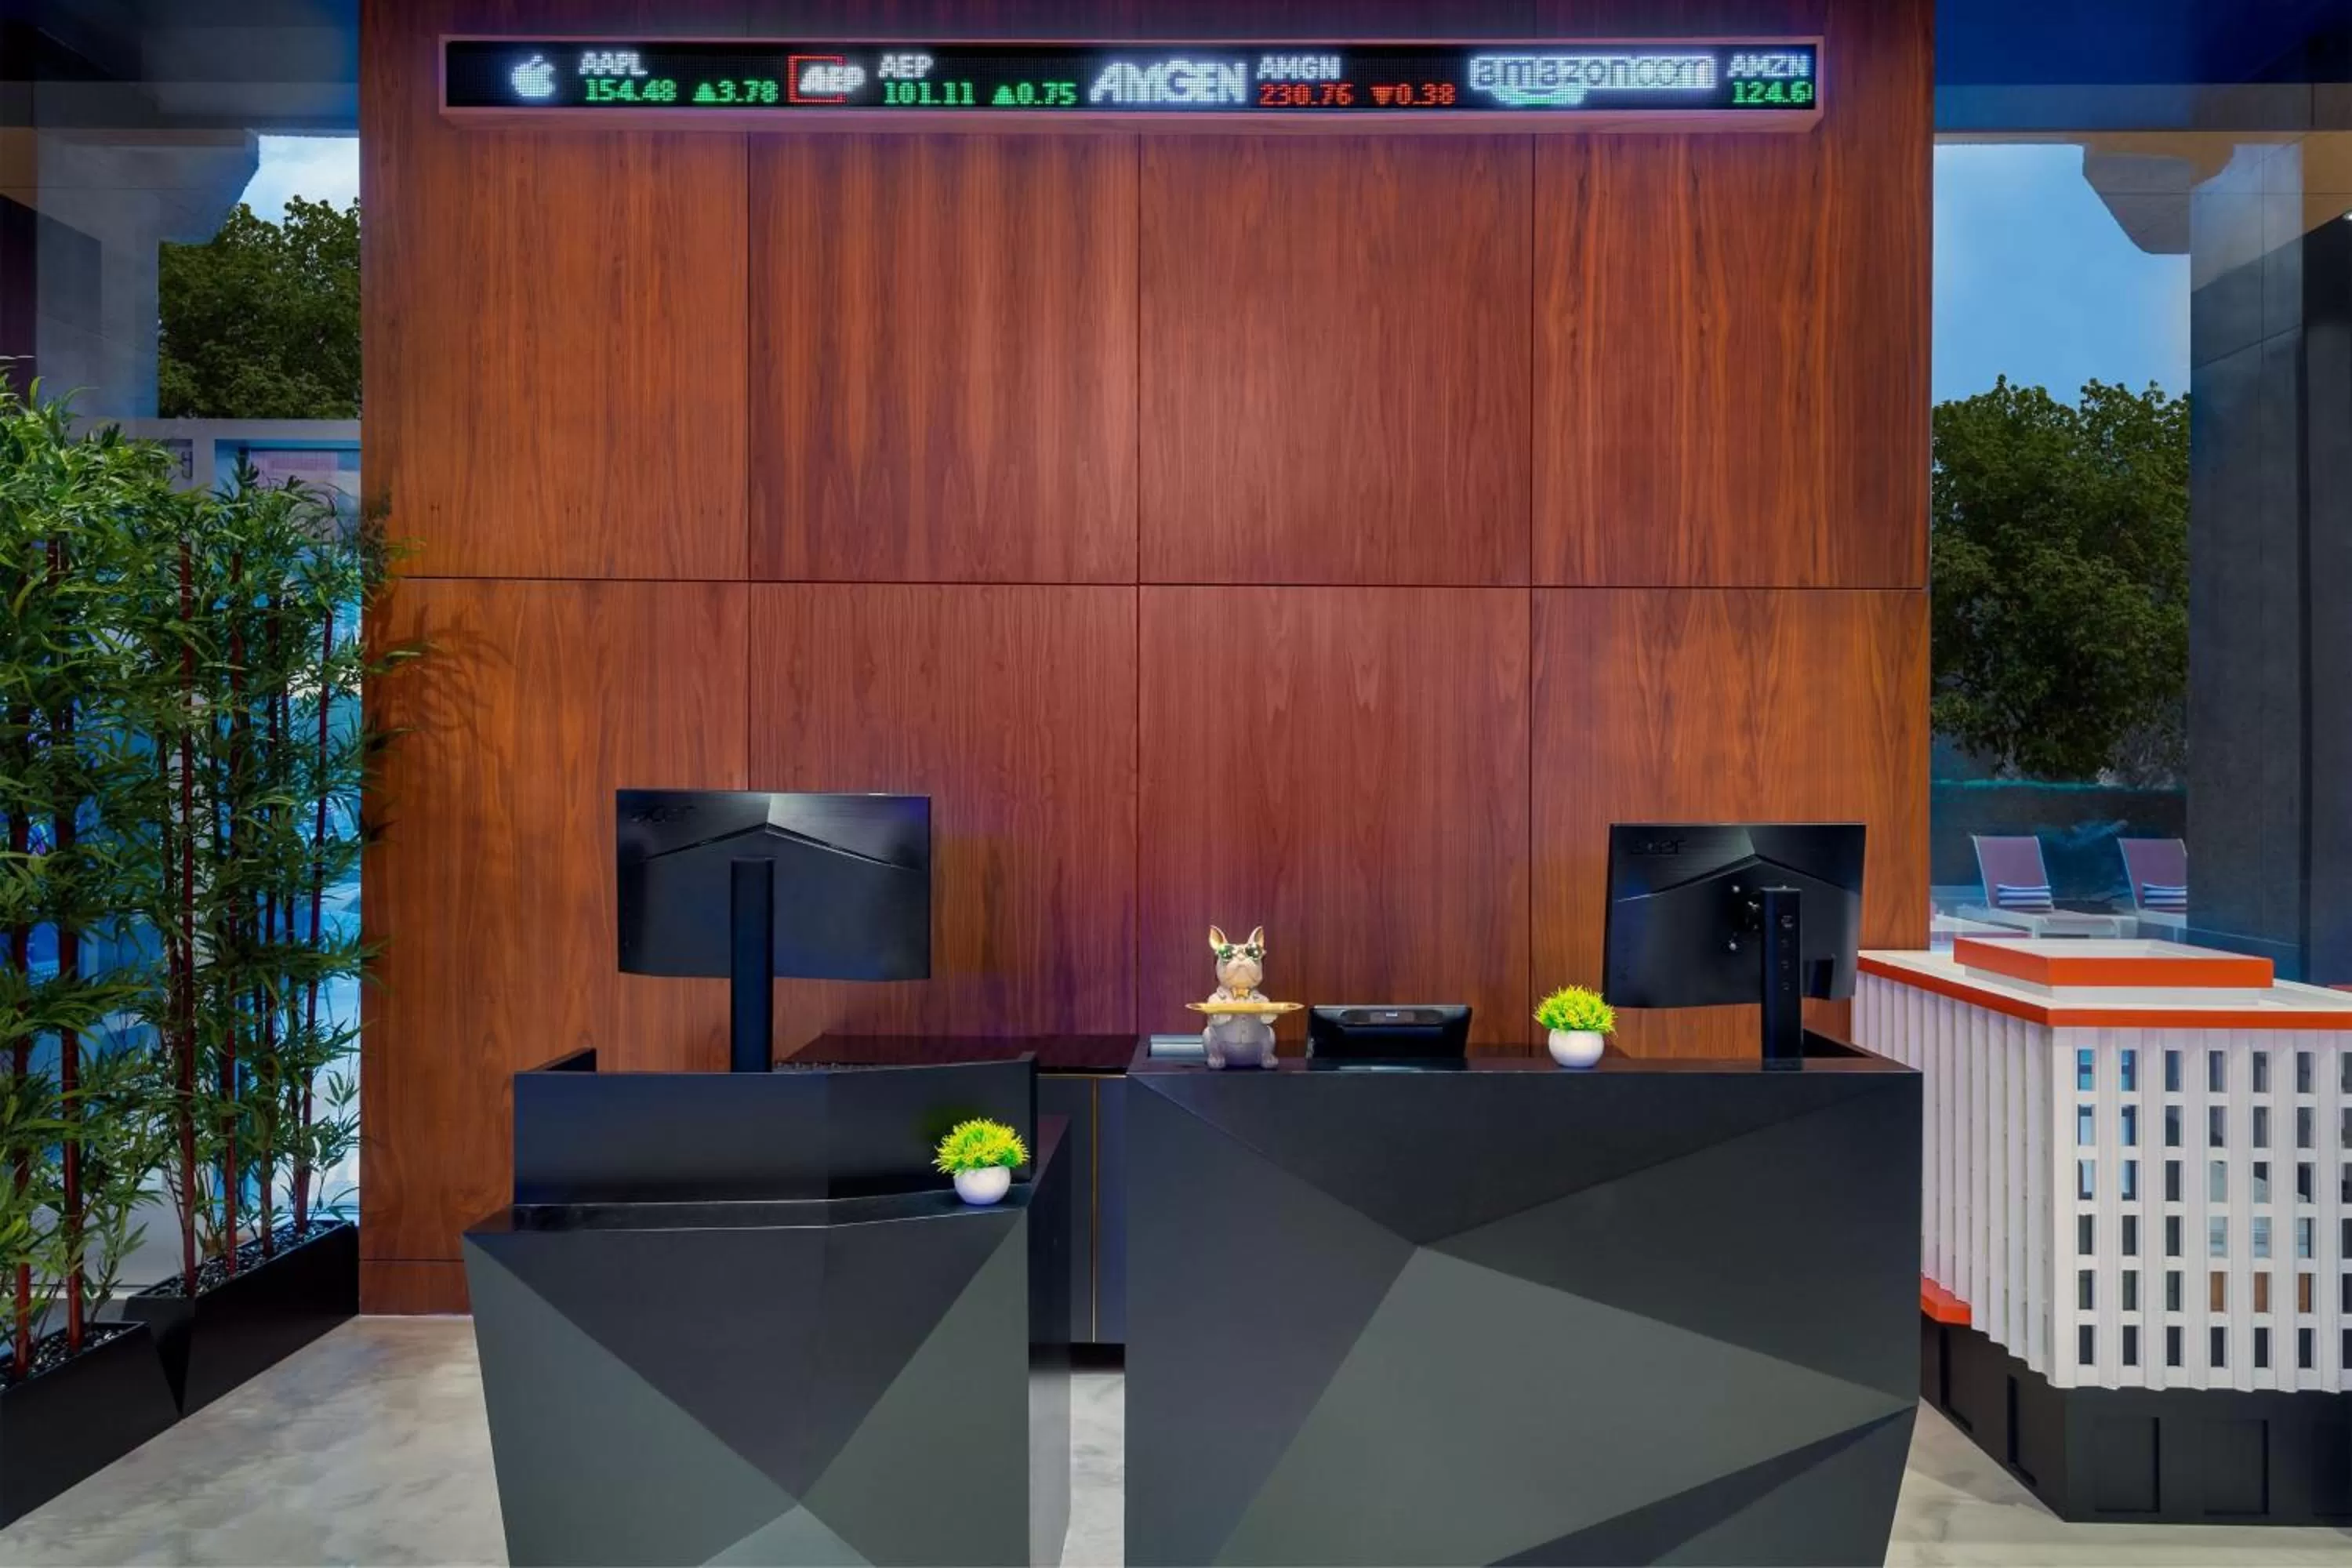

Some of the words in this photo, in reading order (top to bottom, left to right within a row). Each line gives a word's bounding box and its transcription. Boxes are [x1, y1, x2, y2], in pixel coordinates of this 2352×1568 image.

[579, 51, 648, 76] AAPL
[877, 53, 934, 78] AEP
[1256, 55, 1341, 79] AMGN
[1726, 52, 1812, 78] AMZN
[586, 79, 677, 101] 154.48
[717, 80, 779, 103] 3.78
[884, 82, 975, 104] 101.11
[1016, 82, 1077, 104] 0.75
[1089, 59, 1249, 103] AMGEN
[1260, 82, 1353, 105] 230.76
[1396, 83, 1456, 105] 0.38
